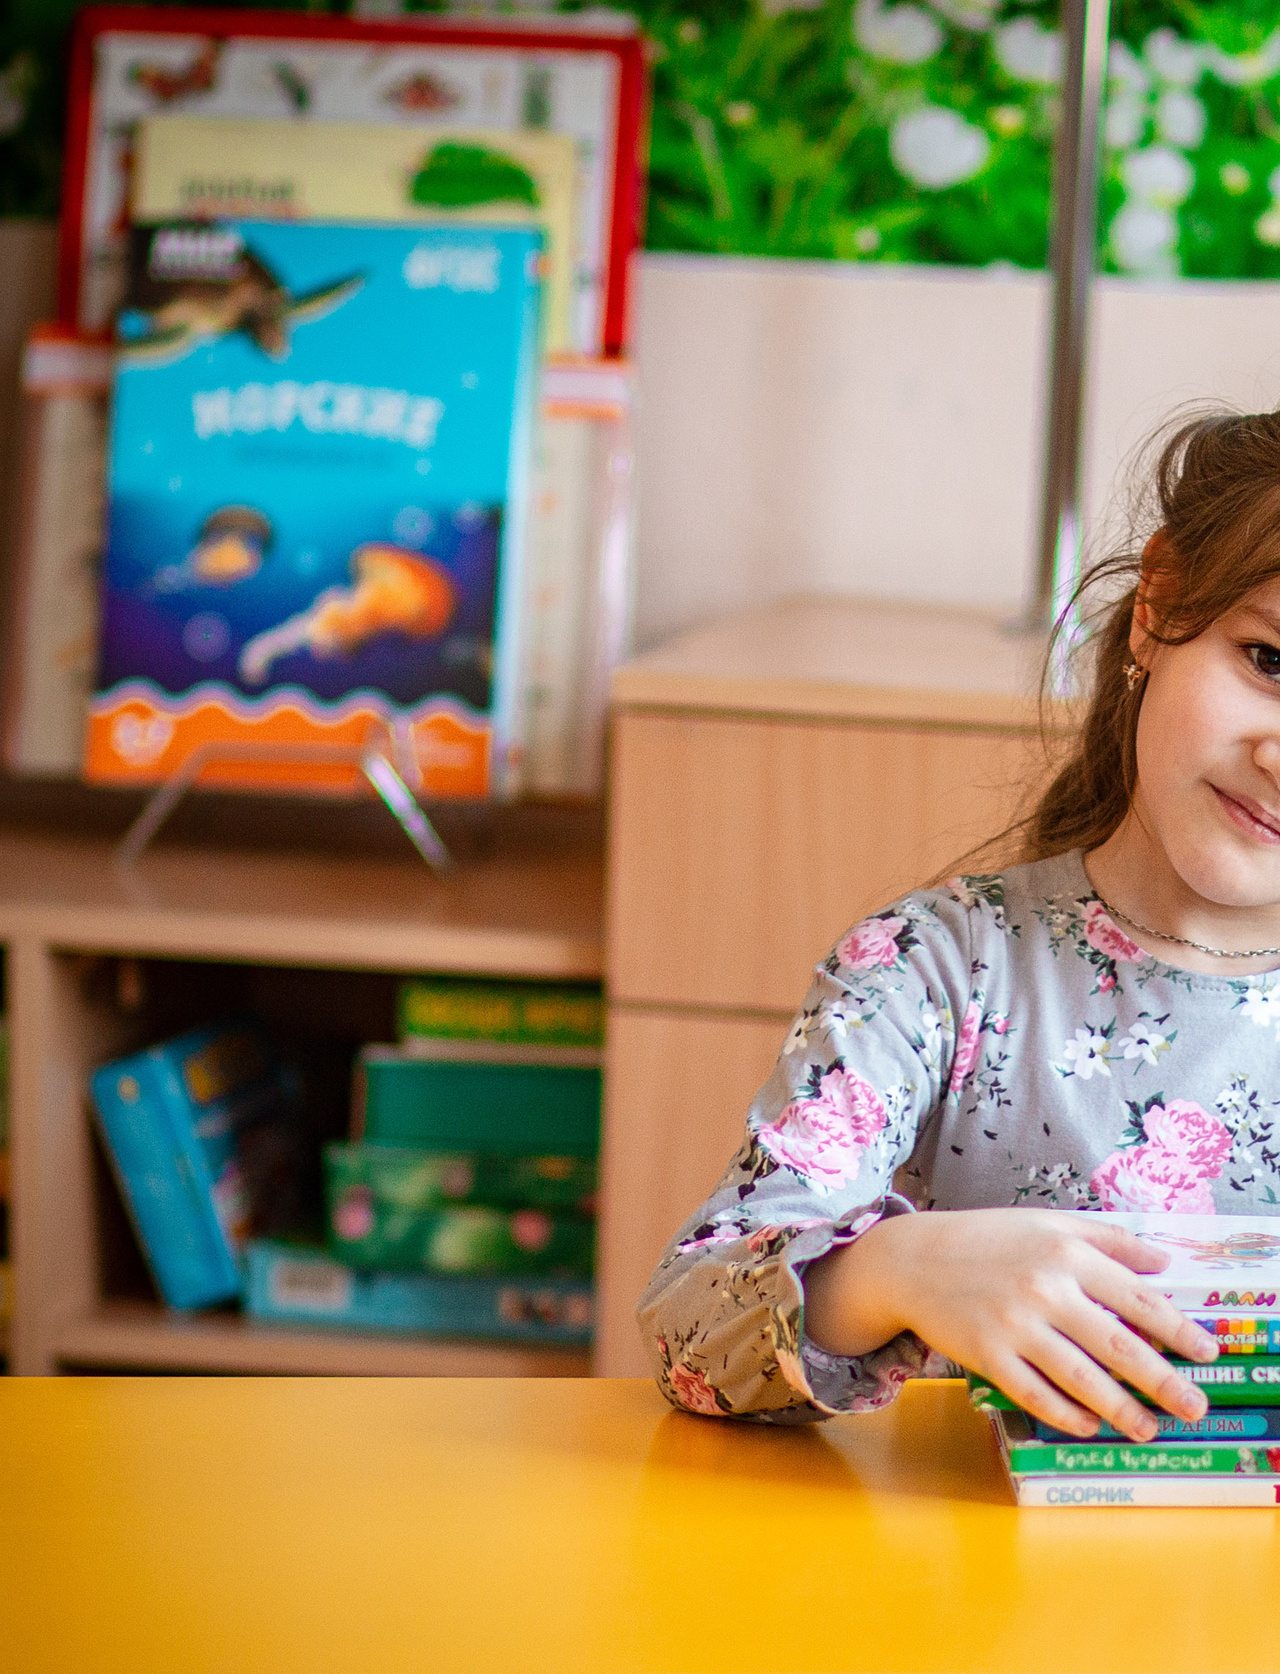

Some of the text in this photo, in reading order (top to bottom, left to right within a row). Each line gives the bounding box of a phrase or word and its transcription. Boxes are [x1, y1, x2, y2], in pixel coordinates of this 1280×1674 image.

[1202, 1291, 1276, 1307] ДАЛИ
[1213, 1330, 1268, 1345] колай
[1176, 1365, 1247, 1384] ЧШИЕ
[1181, 1418, 1244, 1432] ДЕТЯМ
[1046, 1487, 1135, 1503] СБОРНИК
